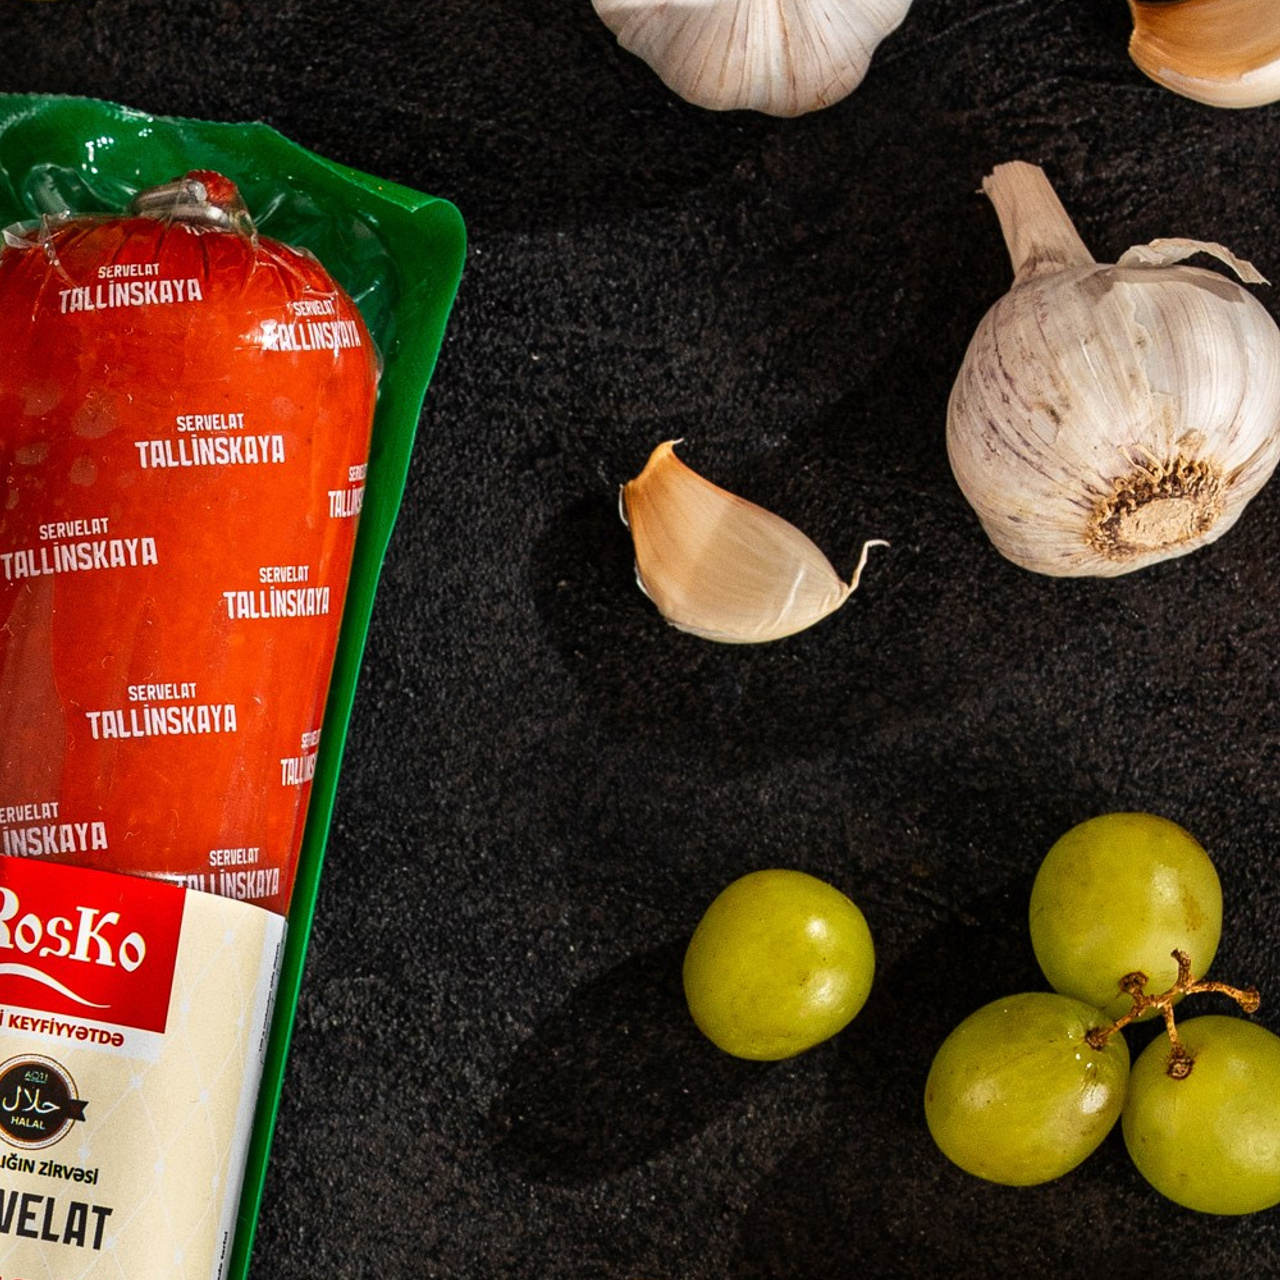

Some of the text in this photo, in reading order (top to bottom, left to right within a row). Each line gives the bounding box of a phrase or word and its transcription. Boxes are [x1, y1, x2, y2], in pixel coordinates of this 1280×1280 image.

[98, 263, 159, 280] SERVELAT
[58, 279, 203, 314] TALLİNSKAYA
[293, 300, 335, 316] SERVELAT
[176, 413, 244, 432] SERVELAT
[135, 435, 285, 469] TALLİNSKAYA
[39, 517, 109, 540] SERVELAT
[0, 537, 158, 581] TALLİNSKAYA
[259, 565, 309, 583] SERVELAT
[223, 586, 330, 620] TALLİNSKAYA
[128, 682, 197, 702] SERVELAT
[86, 703, 237, 740] TALLİNSKAYA
[209, 848, 260, 867] SERVELAT
[8, 1014, 125, 1047] KEYFİYYƏTDƏ
[2, 1085, 60, 1114] حلال
[11, 1116, 46, 1130] HALAL
[38, 1159, 99, 1185] ZİRVƏSİ
